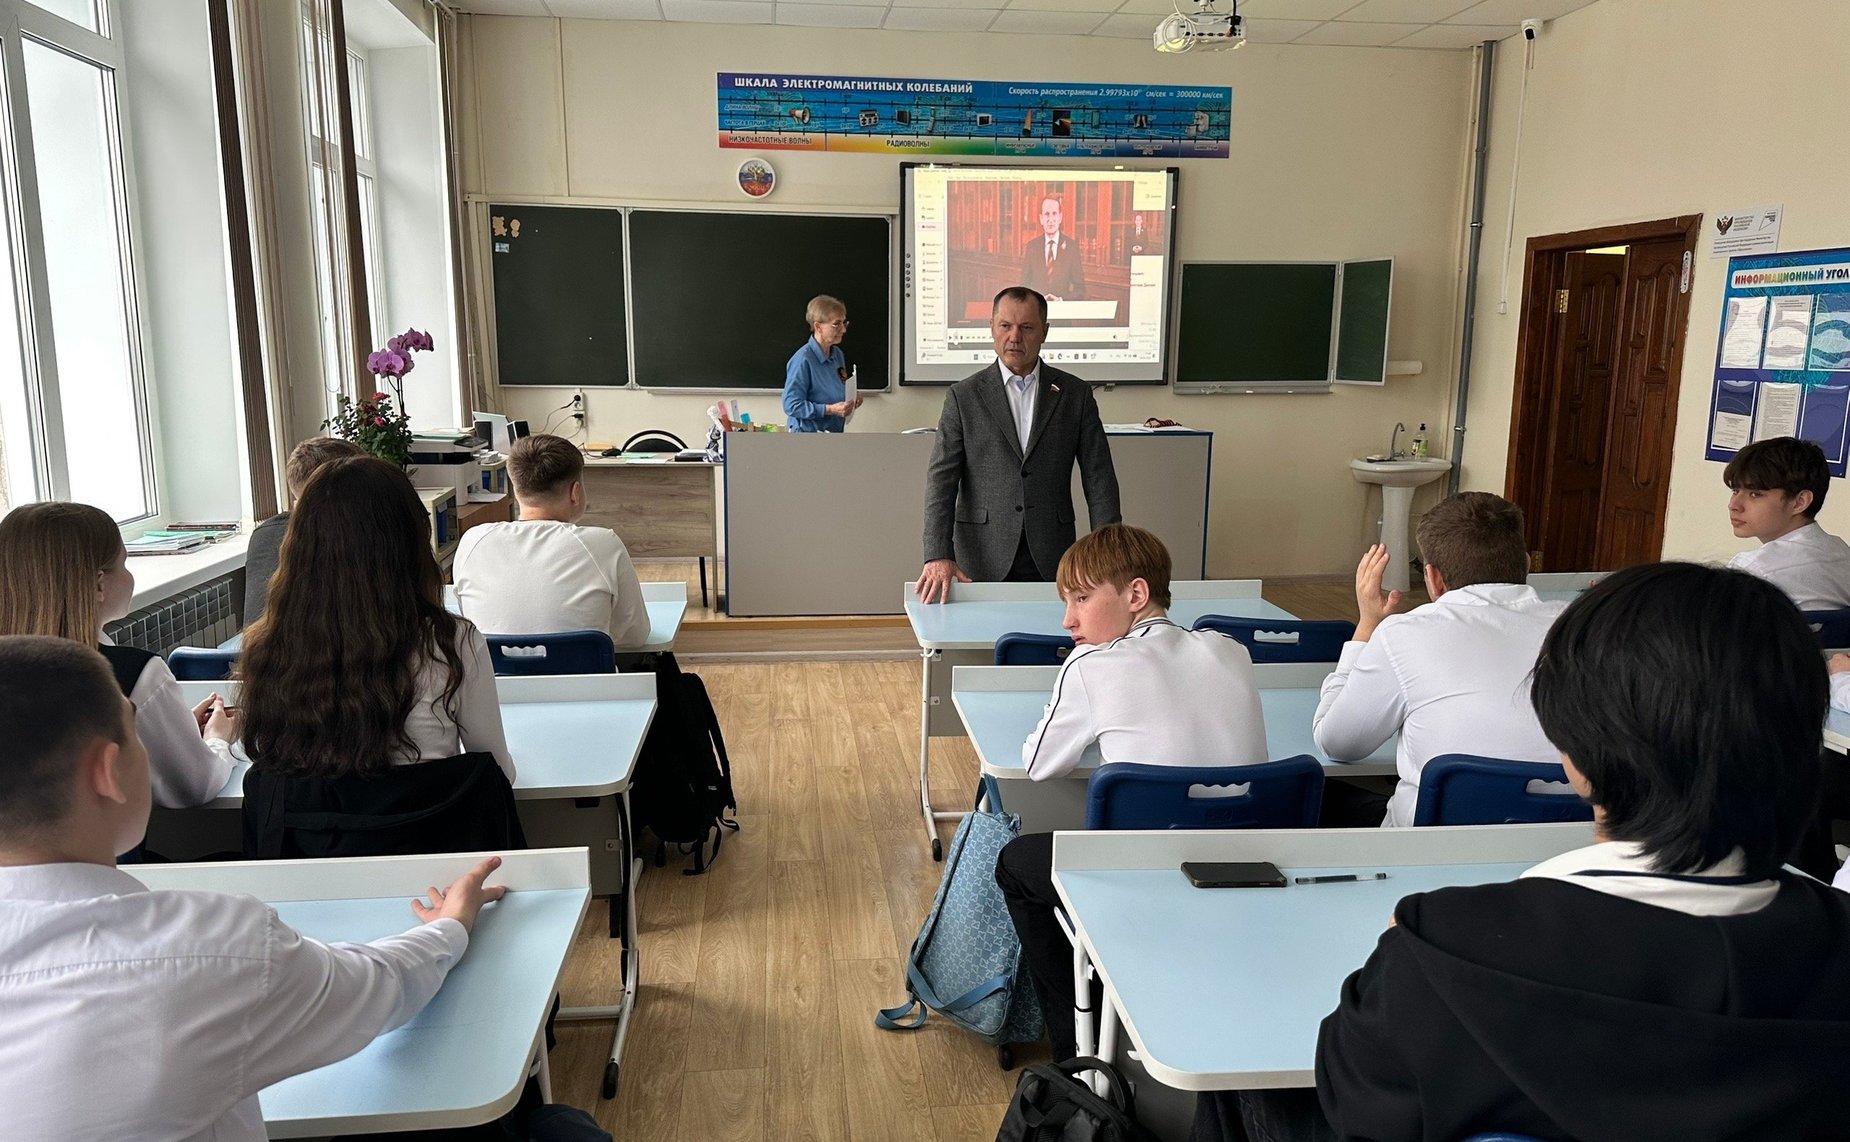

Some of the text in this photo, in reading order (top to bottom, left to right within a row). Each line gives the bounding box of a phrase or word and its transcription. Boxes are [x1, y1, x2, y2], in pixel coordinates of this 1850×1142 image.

[734, 77, 973, 94] ШКАЛА ЭЛЕКТРОМАГНИТНЫХ КОЛЕБАНИЙ
[1008, 86, 1039, 97] Скорость
[1040, 88, 1098, 98] распространения
[1146, 90, 1167, 99] см/сек
[1175, 90, 1200, 99] 300000
[1201, 91, 1223, 100] км/сек
[728, 135, 812, 145] НИЗКОЧАСТОТНЫЕ ВОЛНЫ
[886, 139, 930, 149] РАДИОВОЛНЫ
[1734, 267, 1824, 286] ИНФОРМАЦИОННЫЙ
